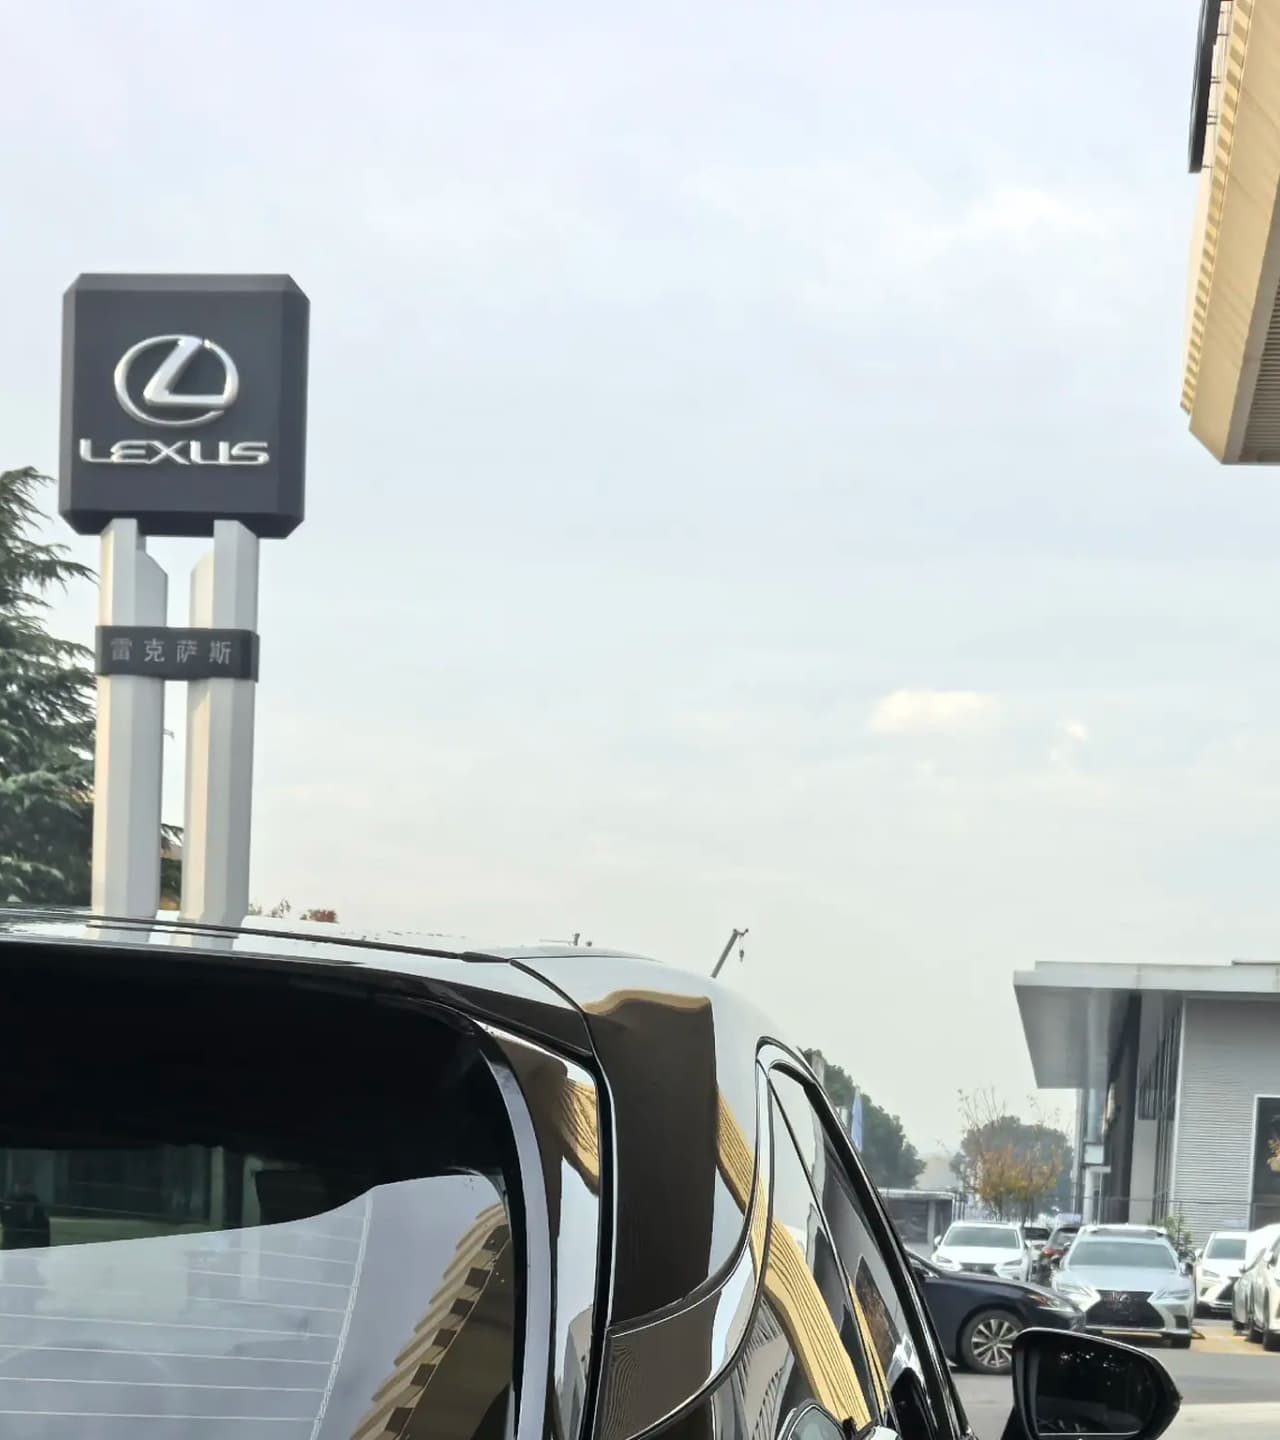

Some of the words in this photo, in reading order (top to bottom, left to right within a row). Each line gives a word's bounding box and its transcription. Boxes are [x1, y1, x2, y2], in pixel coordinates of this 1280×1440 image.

[79, 438, 269, 465] LEXUS
[110, 637, 232, 664] 雷克萨斯
